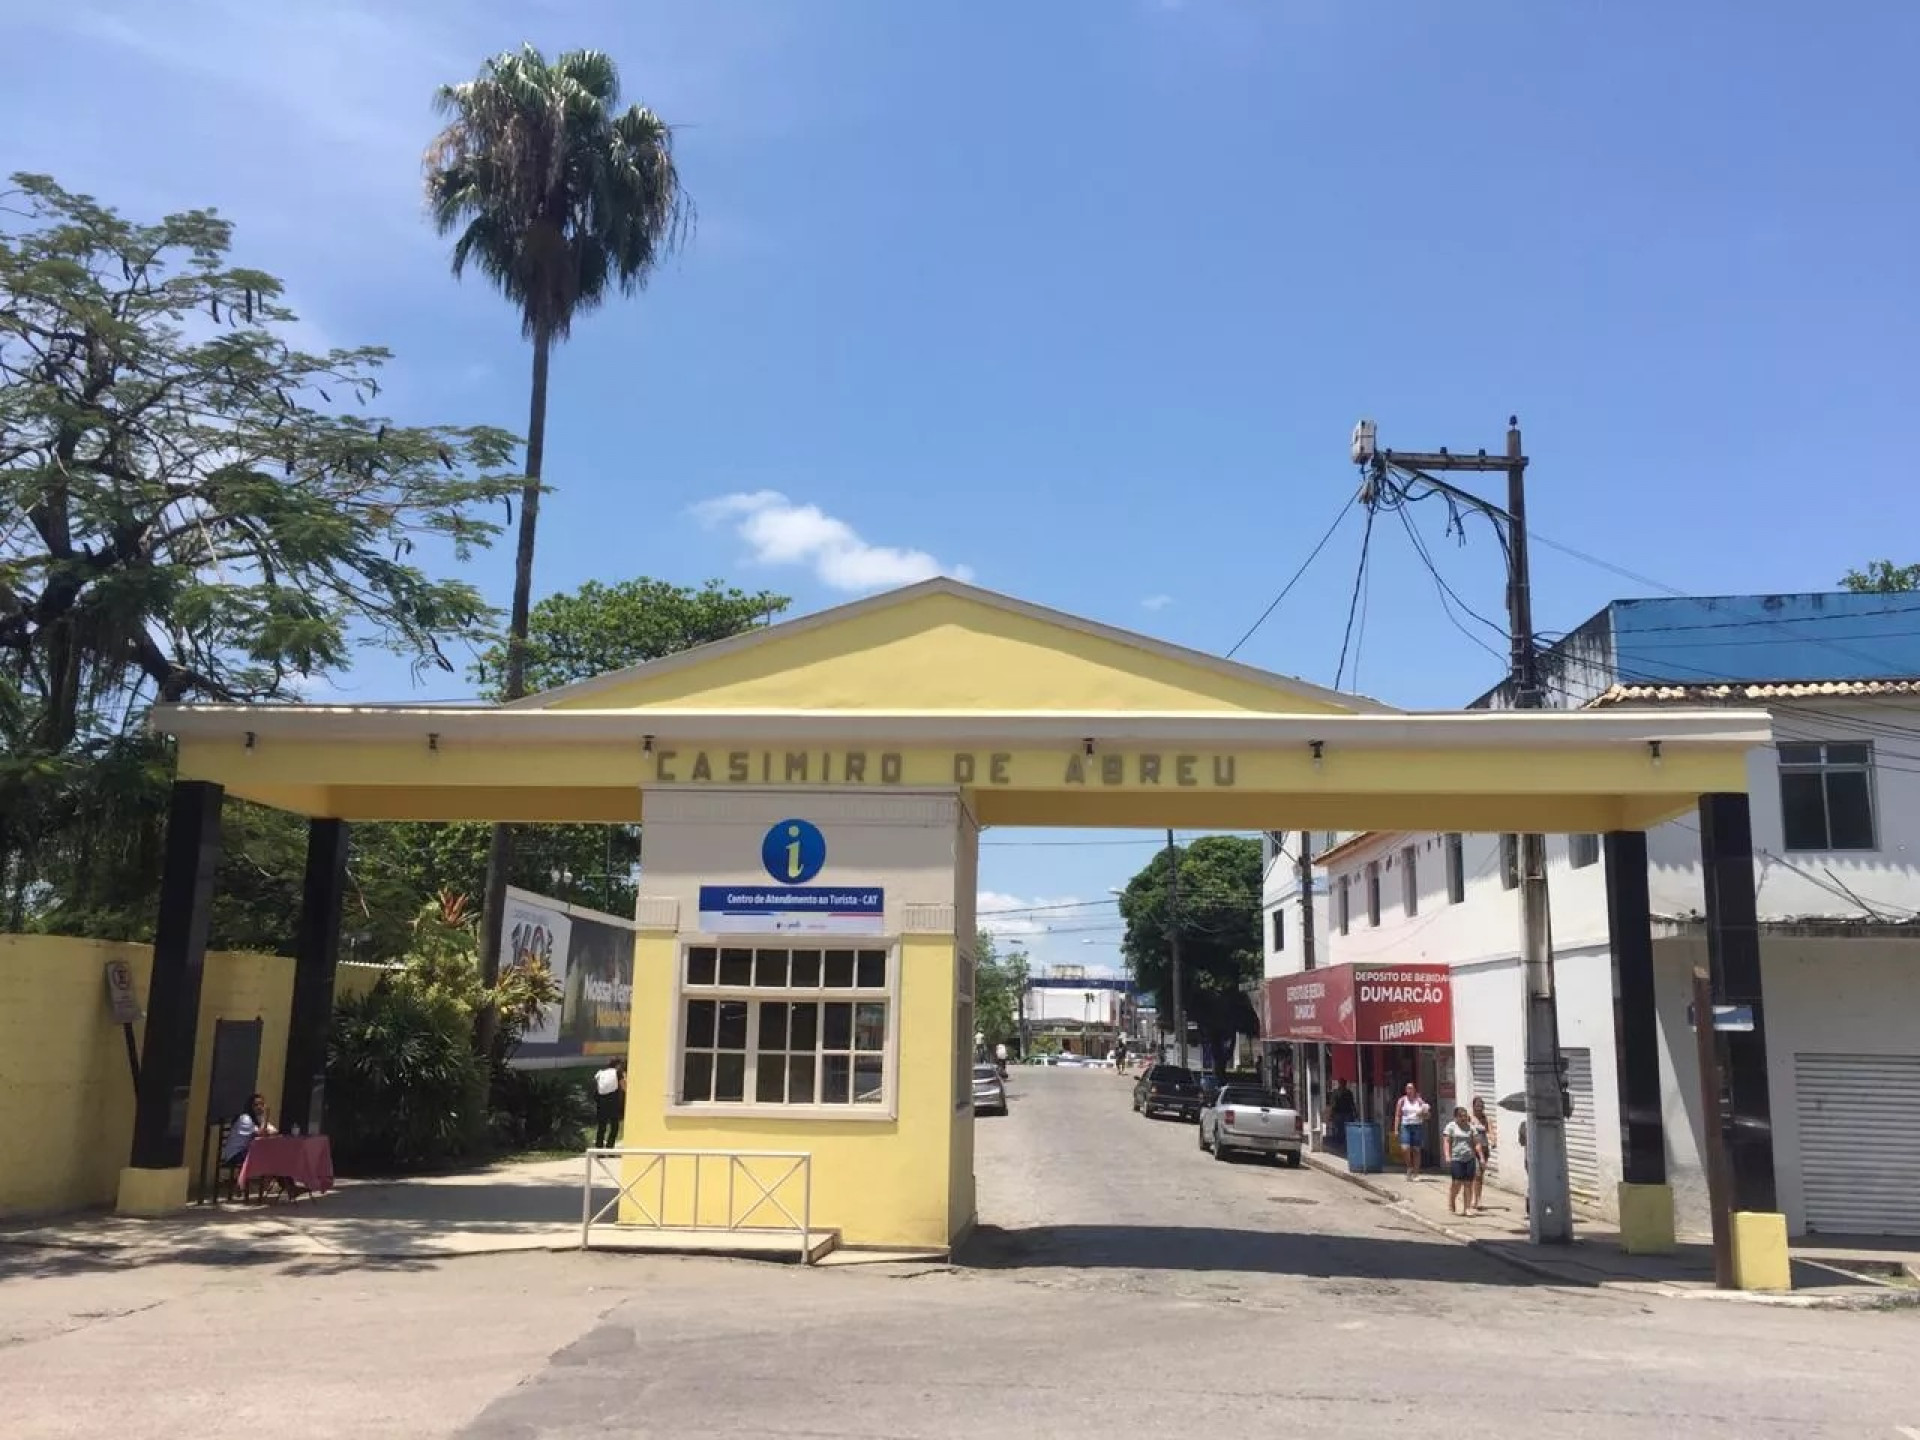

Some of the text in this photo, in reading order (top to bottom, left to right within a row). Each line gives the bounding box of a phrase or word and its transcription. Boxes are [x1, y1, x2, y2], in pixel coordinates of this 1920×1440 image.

[656, 752, 1234, 786] CASIMIRO DE ABREU
[727, 893, 753, 904] Centro
[754, 893, 764, 904] de
[765, 893, 817, 904] Atendimento
[818, 895, 829, 904] ao
[830, 894, 857, 904] Turista
[863, 894, 879, 905] CAT
[1400, 972, 1413, 982] DE
[1380, 1017, 1424, 1041] ITAIPAVA
